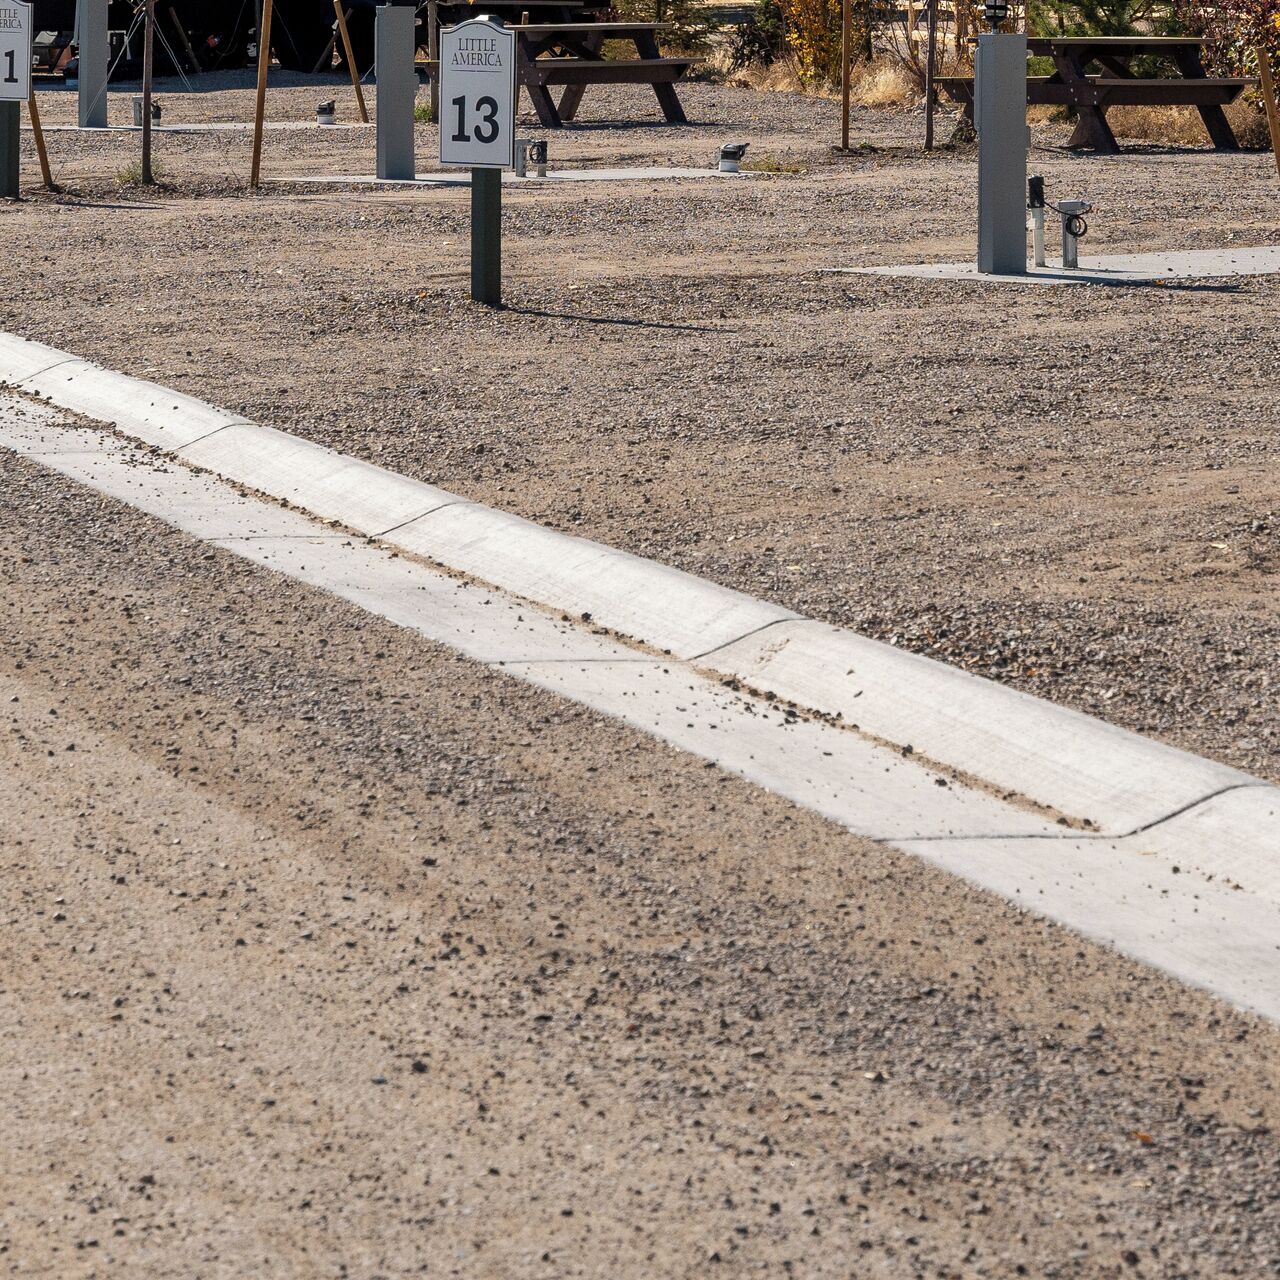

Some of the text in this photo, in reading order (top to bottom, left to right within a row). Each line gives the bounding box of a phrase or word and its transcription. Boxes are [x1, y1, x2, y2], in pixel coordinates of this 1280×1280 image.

[458, 38, 497, 51] LITTLE
[451, 52, 503, 67] AMERICA
[451, 95, 500, 144] 13
